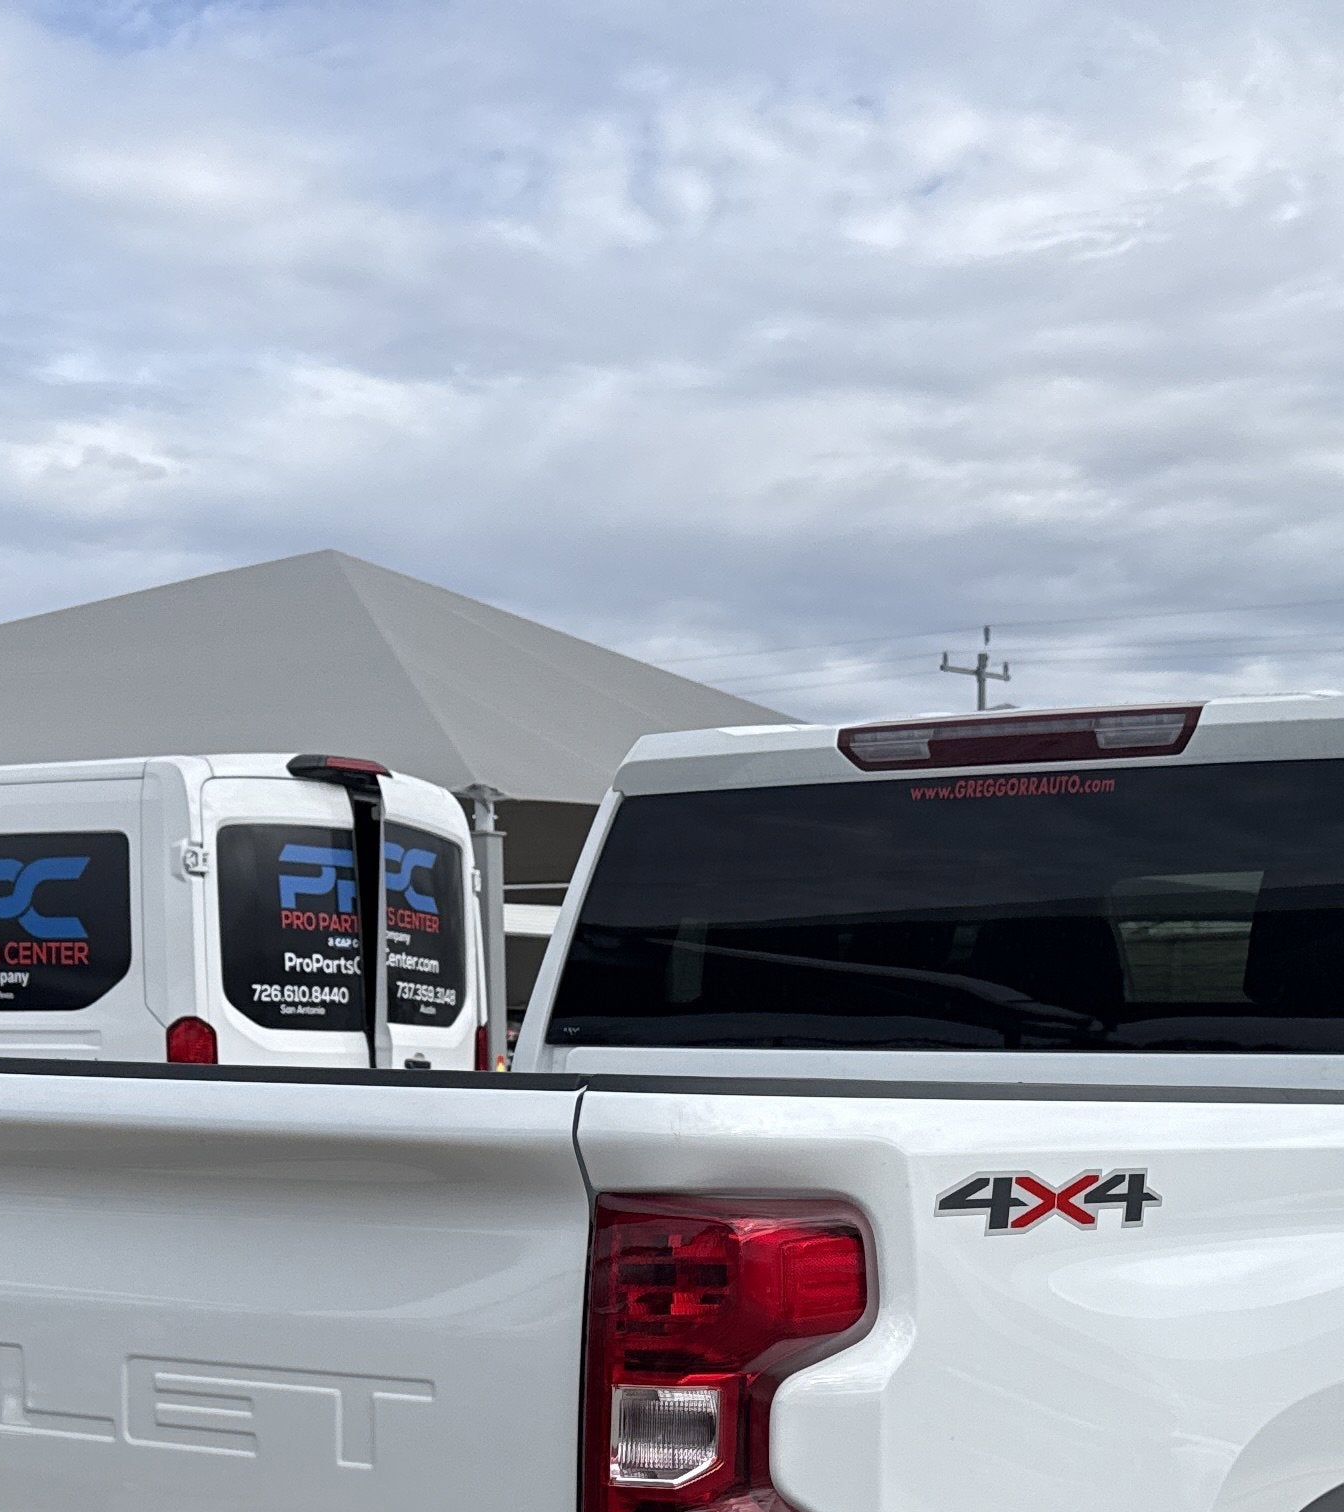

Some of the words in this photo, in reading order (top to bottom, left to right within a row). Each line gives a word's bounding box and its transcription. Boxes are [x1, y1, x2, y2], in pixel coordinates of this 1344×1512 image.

[910, 774, 1115, 800] www.GREGGORRAUTO.com
[281, 910, 316, 931] PRO
[397, 909, 440, 934] CENTER
[4, 941, 89, 965] CENTER
[327, 936, 335, 950] a
[252, 983, 350, 1004] 726.610.8440
[280, 1004, 296, 1015] San
[297, 1004, 327, 1016] Antonio
